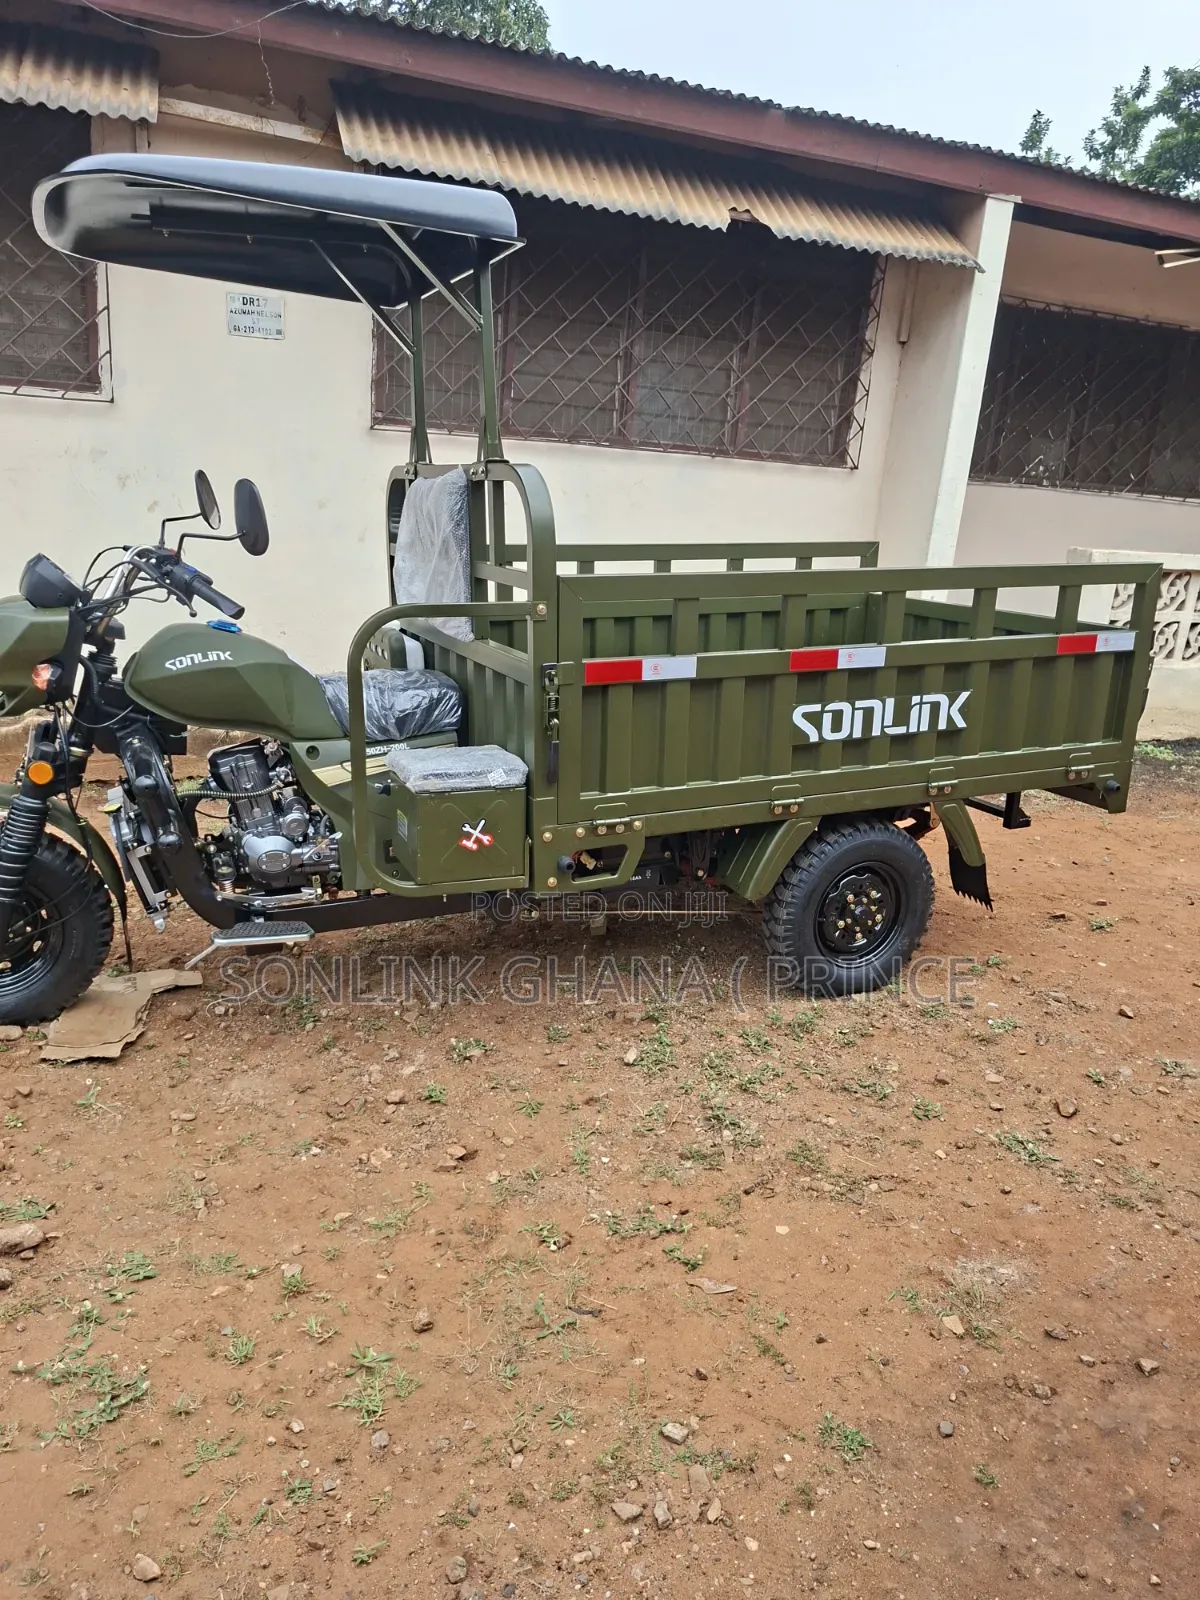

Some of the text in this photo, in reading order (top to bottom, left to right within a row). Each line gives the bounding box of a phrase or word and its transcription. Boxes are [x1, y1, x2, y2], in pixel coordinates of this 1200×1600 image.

[242, 296, 268, 308] DR17
[230, 307, 282, 319] AZUMAH NELSON
